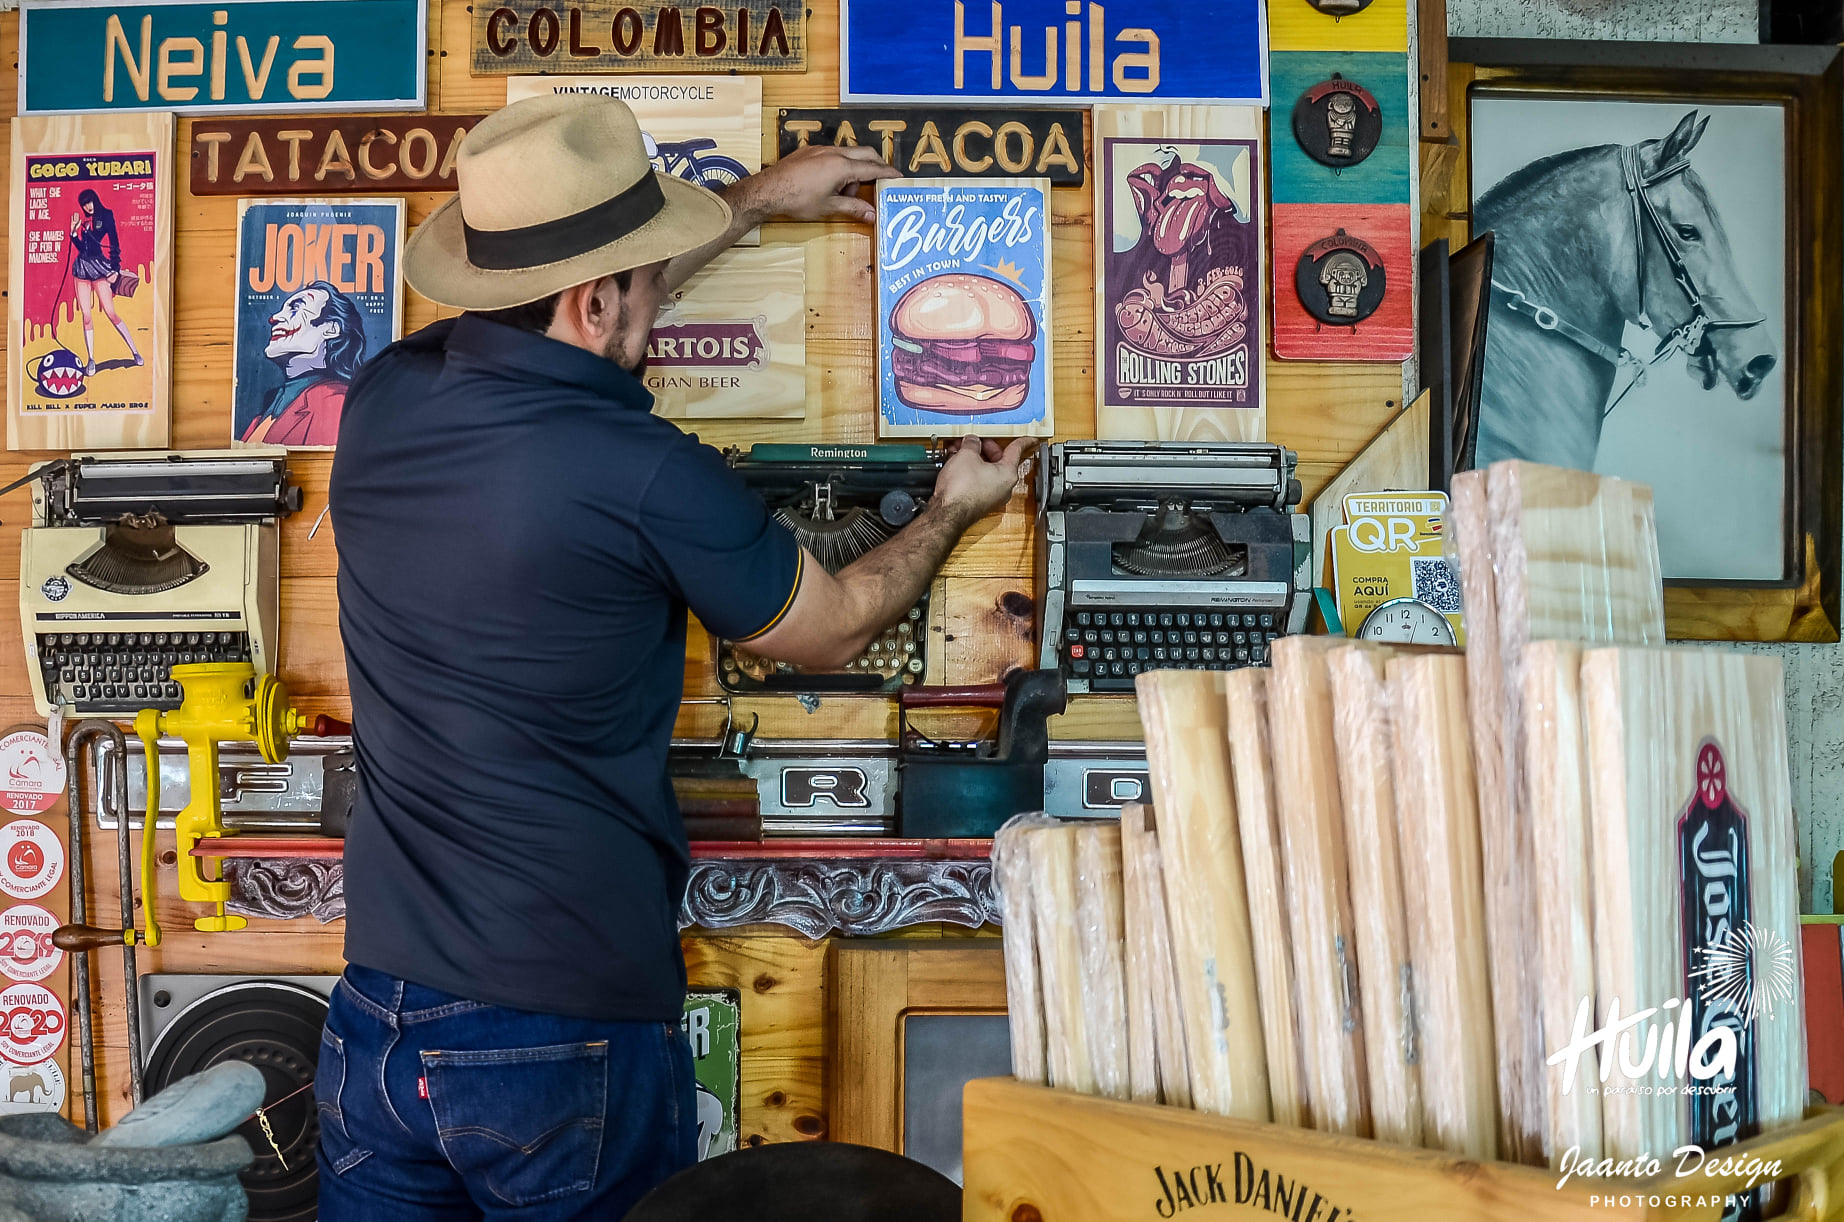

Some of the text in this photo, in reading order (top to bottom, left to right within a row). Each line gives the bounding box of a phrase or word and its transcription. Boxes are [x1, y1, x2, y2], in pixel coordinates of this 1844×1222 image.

[487, 7, 790, 58] COLOMBIA
[954, 0, 1161, 93] Huila
[103, 10, 335, 102] Neiva
[30, 160, 152, 178] GOGO YUBARI
[30, 187, 61, 198] WHAT SHE
[886, 194, 924, 203] ALWAYS
[956, 194, 976, 203] AND
[978, 194, 1008, 203] TASTY!
[29, 230, 64, 242] SHE MAKES
[882, 195, 1038, 271] Burgers
[28, 242, 38, 252] UP
[40, 242, 53, 252] FOR
[249, 224, 386, 293] JOKER
[889, 259, 961, 294] BEST IN TOWN
[1120, 348, 1246, 385] ROLLING STONES
[700, 377, 740, 388] BEER
[811, 447, 867, 458] Remington
[1356, 502, 1422, 513] TERRITORIO
[1350, 517, 1418, 550] QR
[1386, 613, 1393, 623] 11
[1401, 610, 1411, 619] 12
[1422, 614, 1425, 623] 1
[1373, 626, 1382, 635] 10
[1432, 627, 1439, 636] 2
[12, 800, 37, 809] 2017
[1, 862, 58, 893] COMERCIANTE LEGAL
[5, 915, 50, 926] RENOVADO
[0, 929, 55, 965] 2019
[3, 994, 49, 1006] RENOVADO
[0, 1006, 63, 1045] 2020
[9, 1047, 41, 1058] COMERCIANTE
[41, 1041, 55, 1054] LEGAL
[1154, 1163, 1227, 1219] JACK
